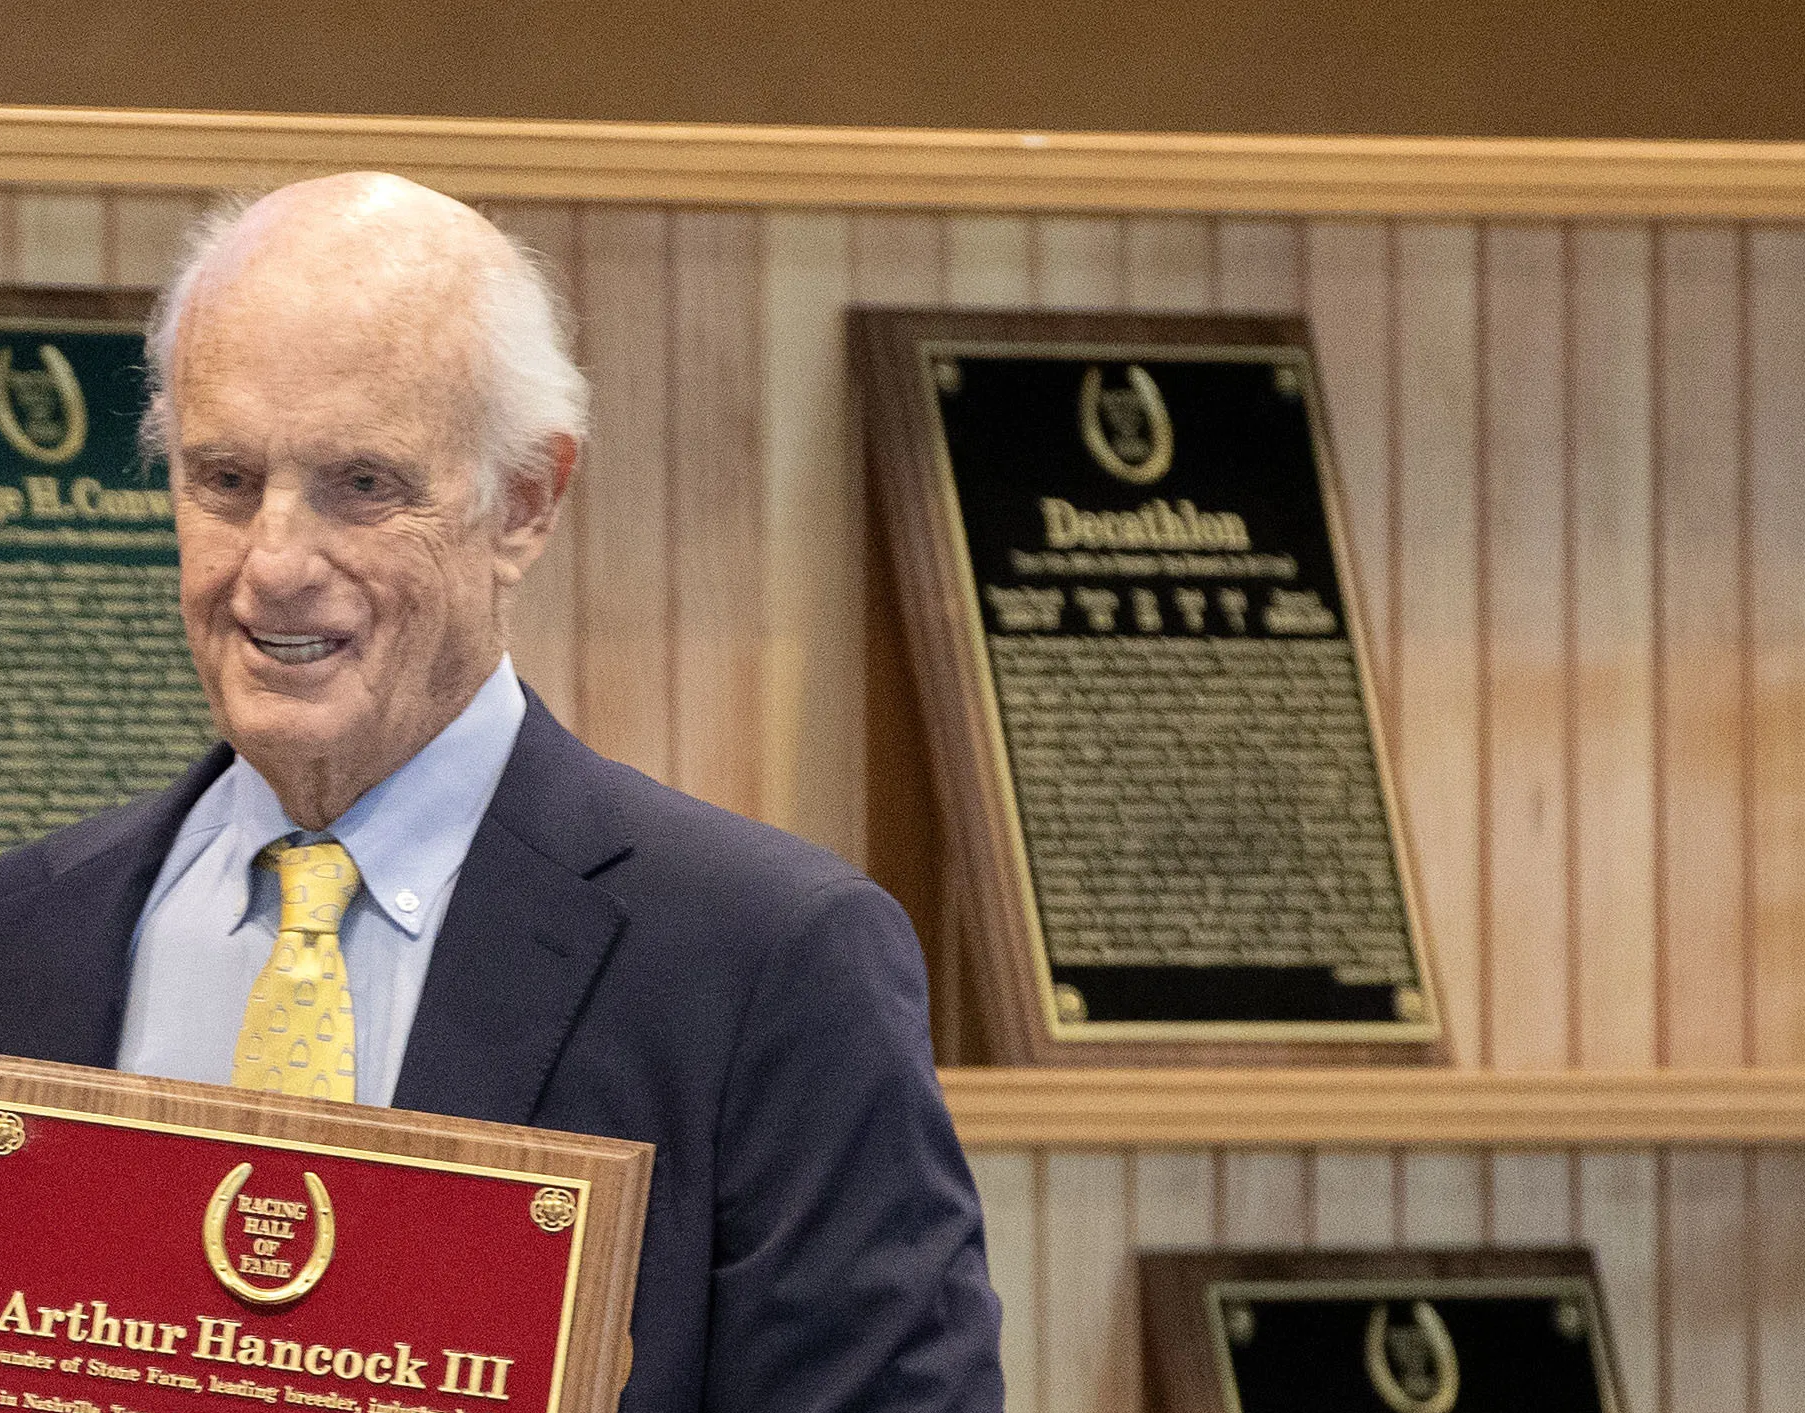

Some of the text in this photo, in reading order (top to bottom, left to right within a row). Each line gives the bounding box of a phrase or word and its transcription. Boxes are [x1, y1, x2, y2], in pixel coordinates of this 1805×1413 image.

[238, 1195, 306, 1219] RACING
[243, 1216, 294, 1238] HALL
[253, 1238, 280, 1256] OF
[239, 1254, 291, 1277] FAME
[194, 1316, 425, 1387] Hancock
[438, 1349, 512, 1399] III
[59, 1356, 83, 1373] of
[86, 1358, 140, 1380] Stone
[146, 1366, 202, 1392] Farm,
[209, 1375, 278, 1402] leading
[284, 1385, 361, 1413] breeder,
